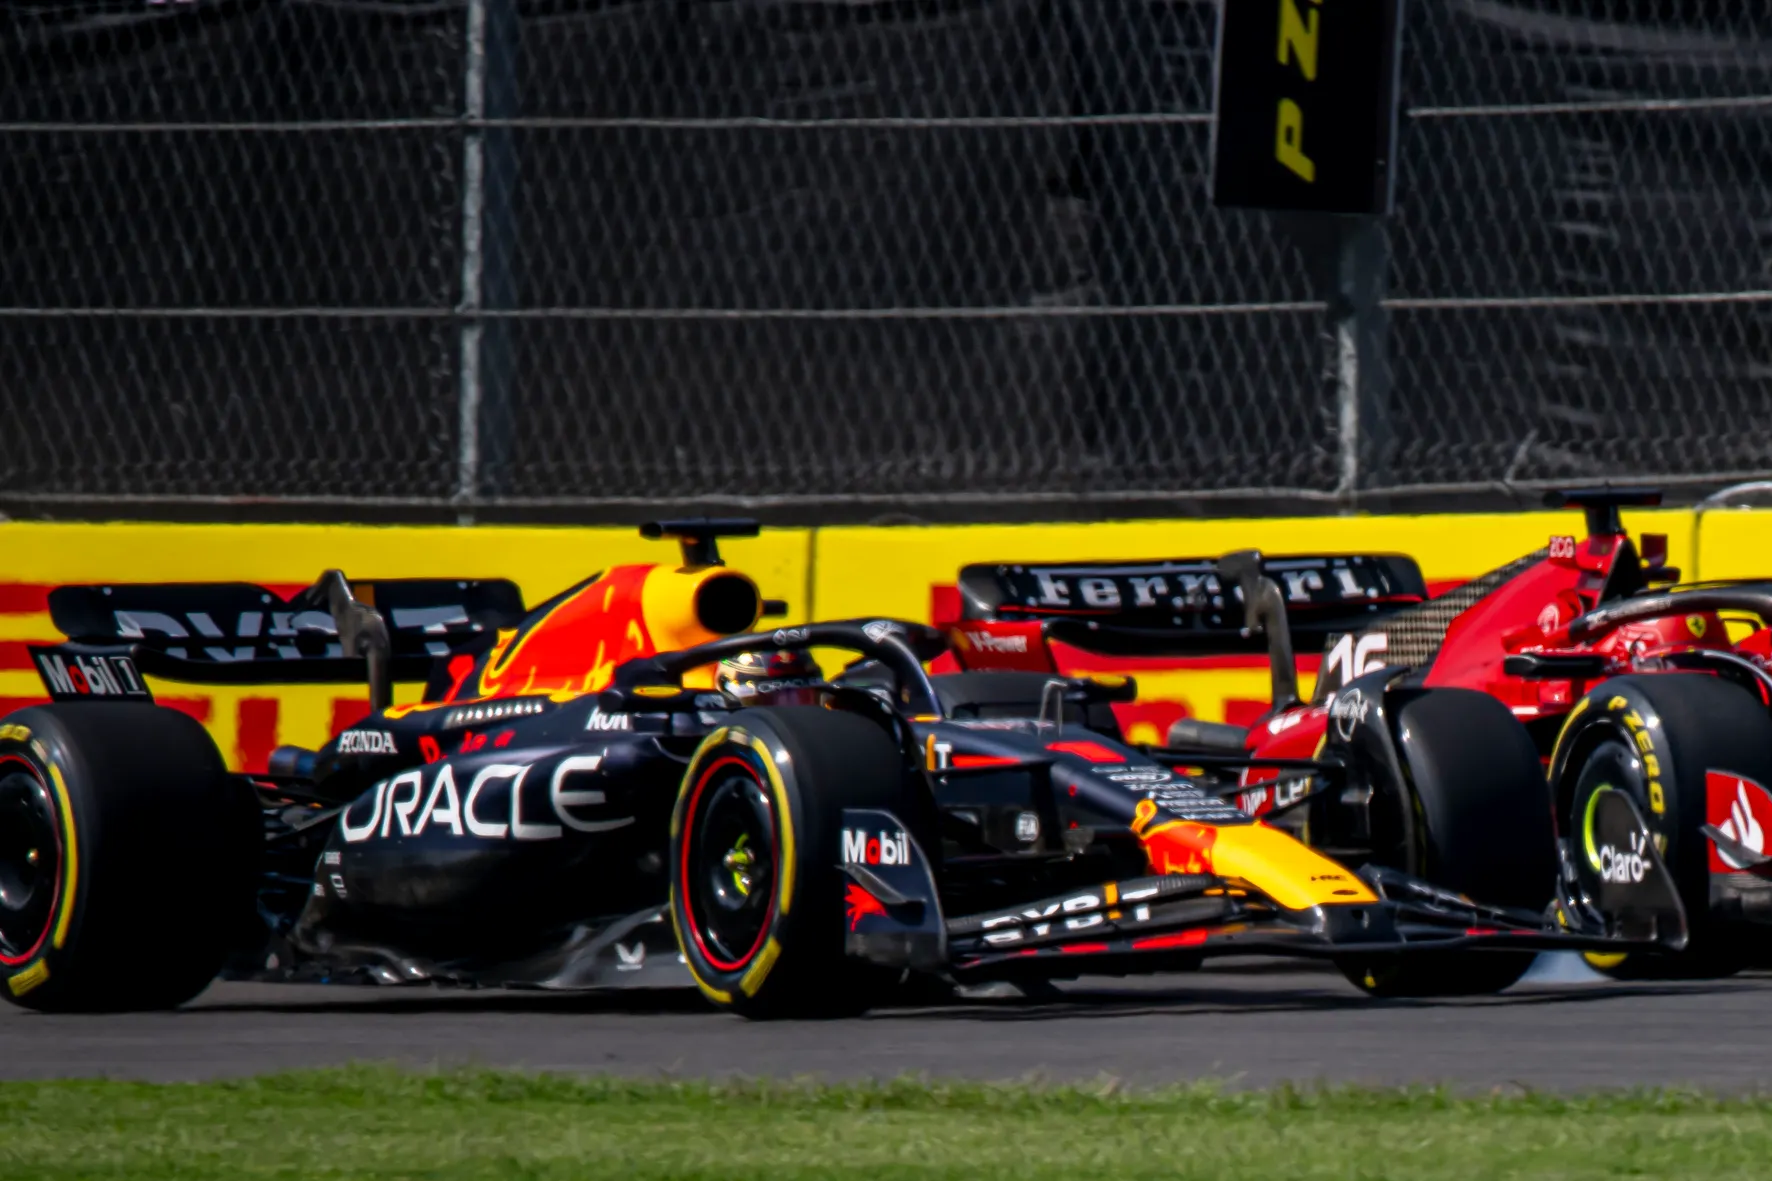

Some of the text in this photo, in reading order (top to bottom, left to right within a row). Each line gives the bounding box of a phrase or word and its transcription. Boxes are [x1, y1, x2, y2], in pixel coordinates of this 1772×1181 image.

[1275, 0, 1322, 183] P Z
[1026, 560, 1370, 608] Ferrri
[38, 654, 121, 695] Mobil
[337, 730, 398, 754] HONDA
[1623, 709, 1667, 814] ZERO
[341, 755, 636, 842] ORACLE
[842, 830, 910, 865] Mobil
[1600, 840, 1650, 883] Claro
